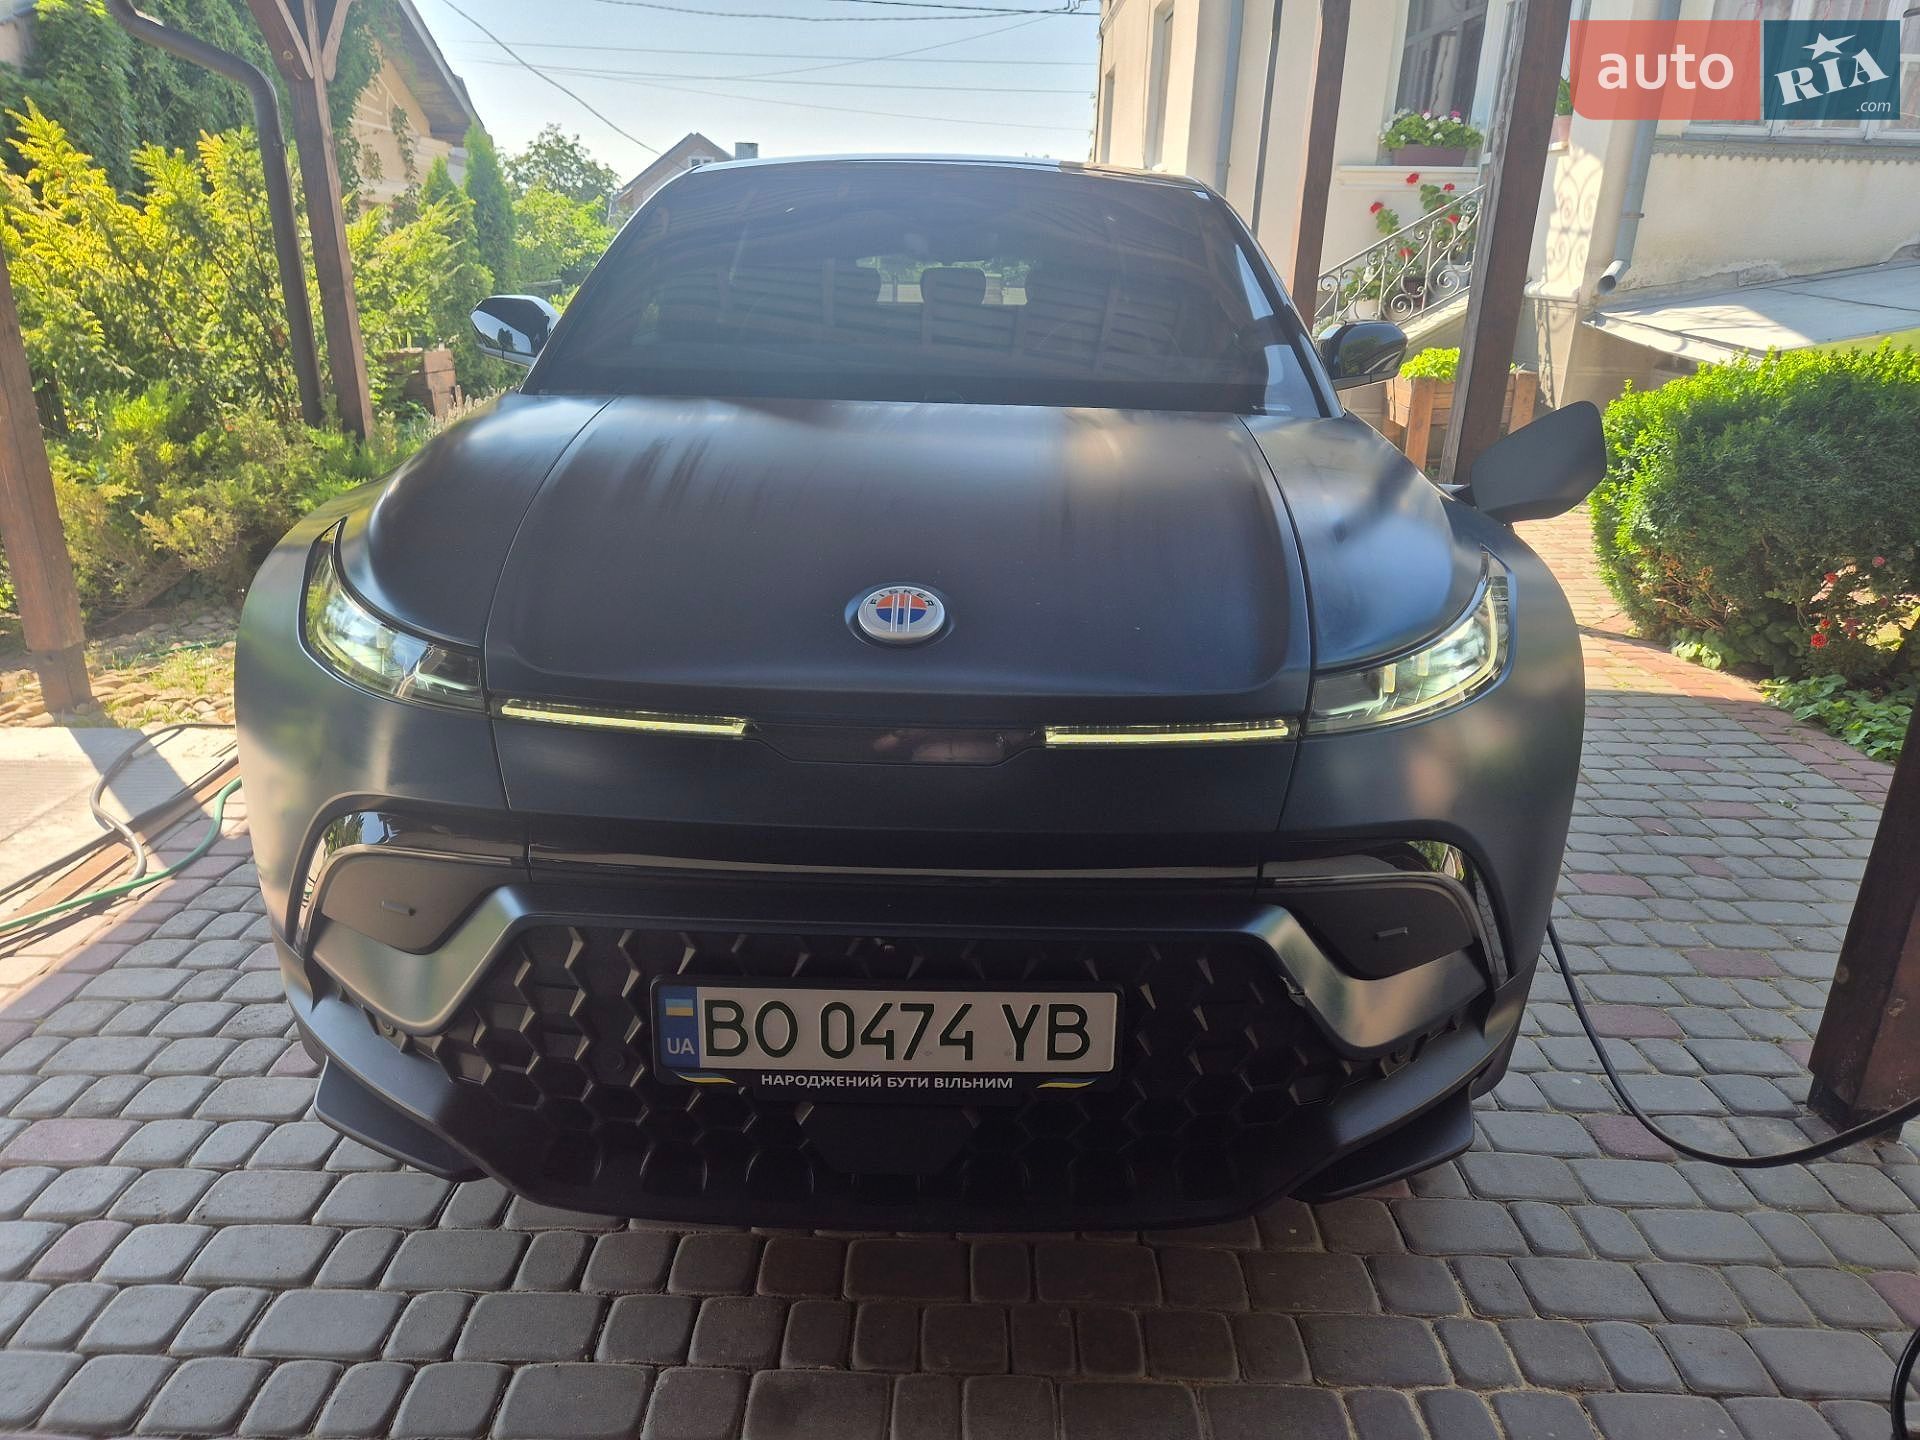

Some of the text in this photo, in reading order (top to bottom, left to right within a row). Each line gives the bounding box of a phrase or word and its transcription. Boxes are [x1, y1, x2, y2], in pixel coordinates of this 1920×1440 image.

[820, 1001, 974, 1061] 0474
[666, 1037, 695, 1056] UA
[761, 1073, 1014, 1090] НАРОДЖЕНИЙ БУТИ ВІЛЬНИМ
